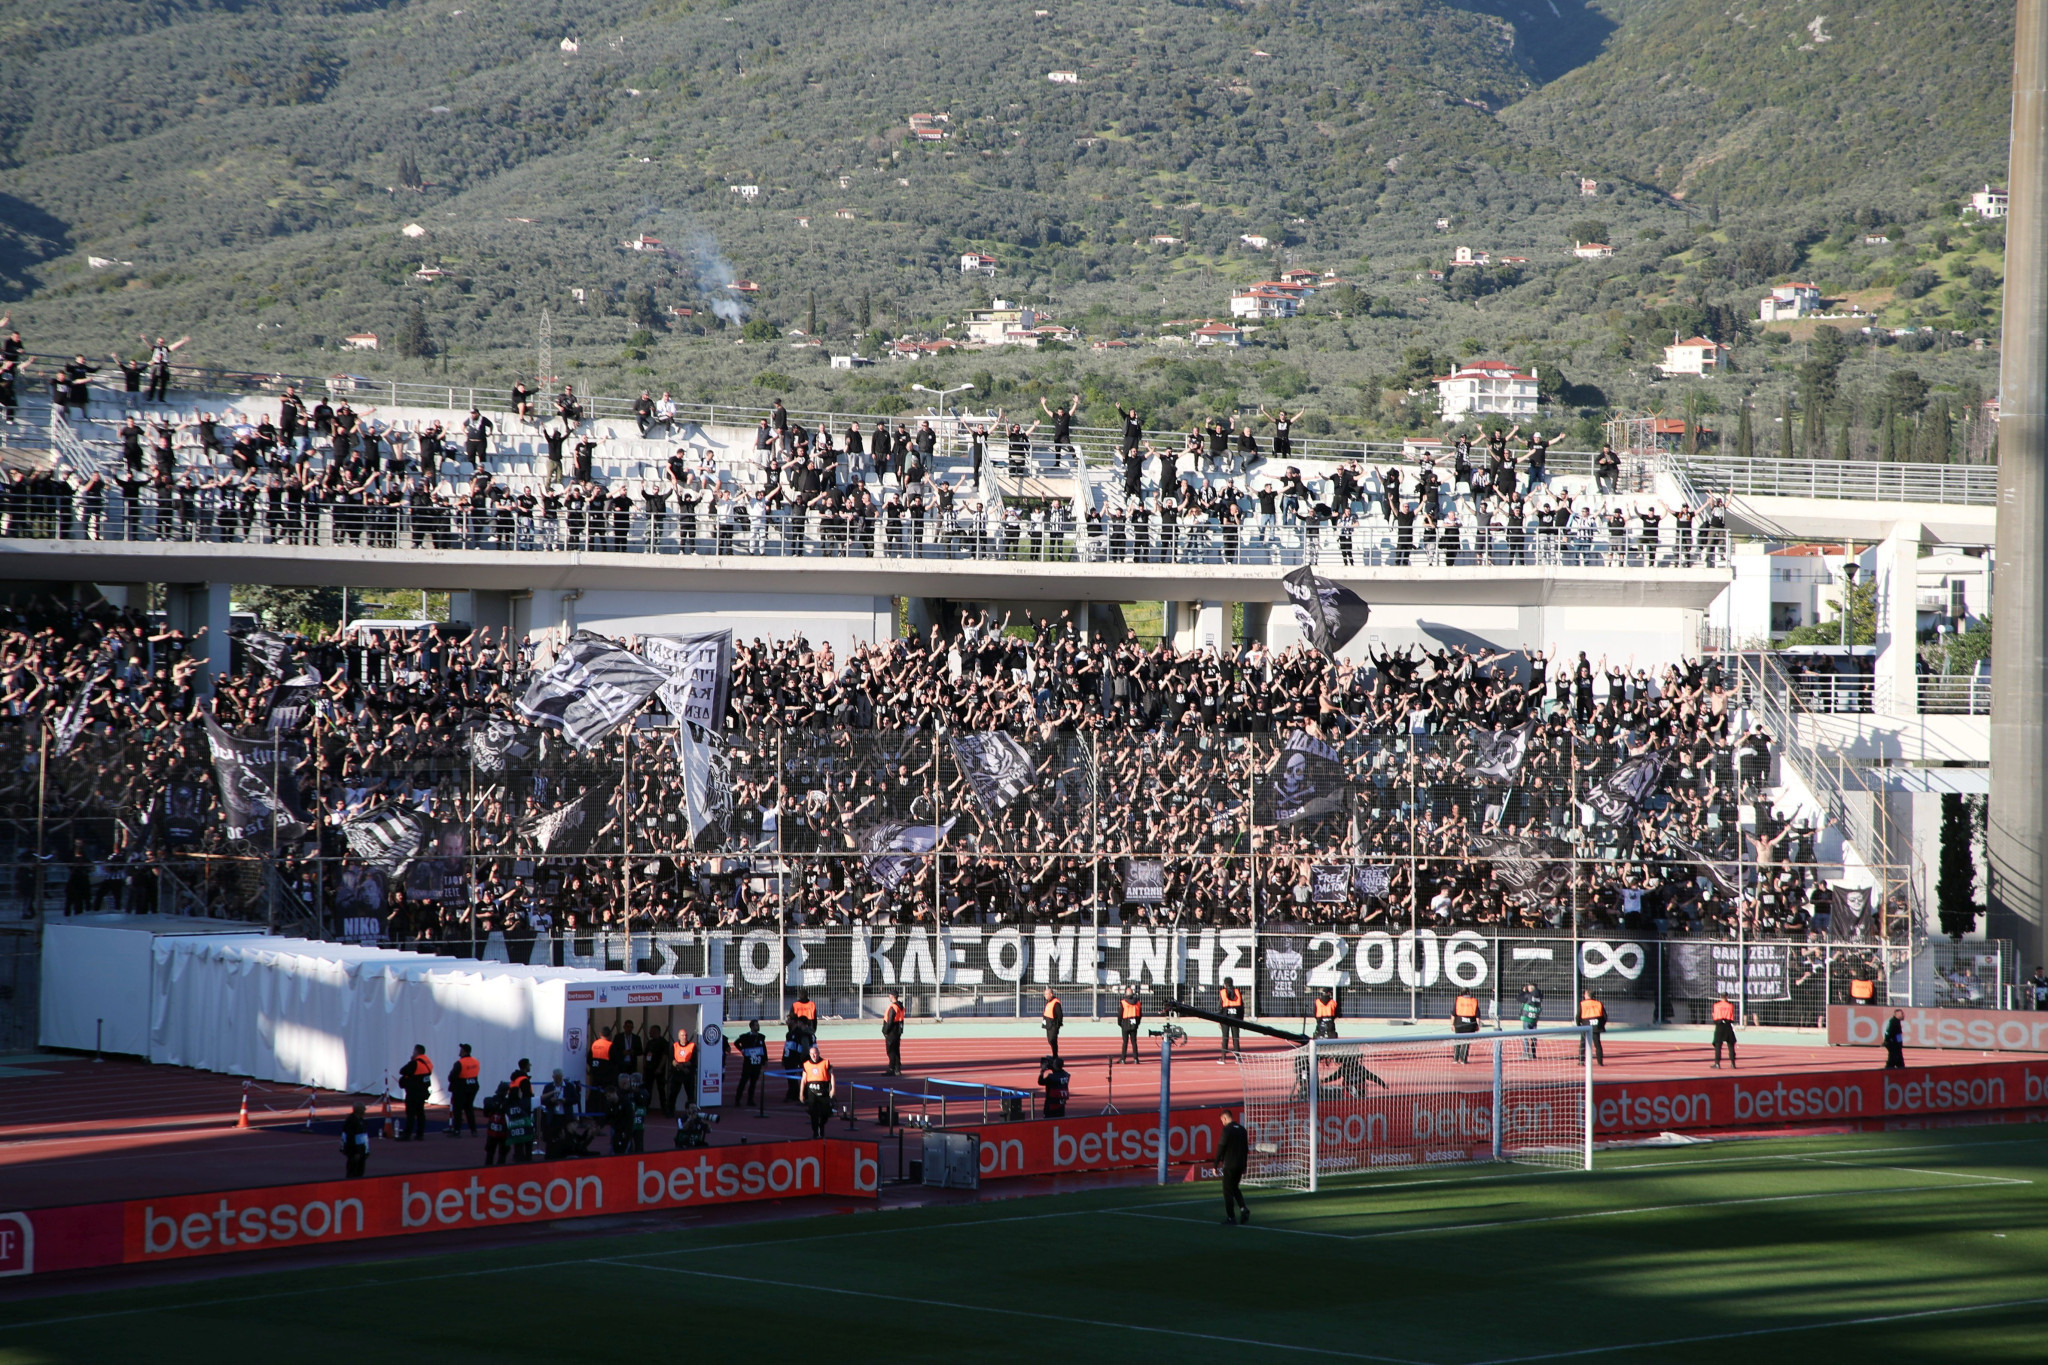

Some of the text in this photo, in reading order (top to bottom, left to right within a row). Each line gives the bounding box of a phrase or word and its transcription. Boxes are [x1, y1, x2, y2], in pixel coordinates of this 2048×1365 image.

[1314, 881, 1347, 893] DALTON
[1317, 873, 1342, 884] FREE
[851, 926, 1258, 986] ΚΛΕΟΜΕΝΗΣ
[1306, 929, 1489, 987] 2006
[1716, 963, 1737, 977] ΓΙΑ
[1734, 1081, 1863, 1119] betsson
[1884, 1073, 2005, 1110] betsson
[1053, 1122, 1212, 1165] betsson
[637, 1155, 821, 1204] betsson
[402, 1174, 603, 1227] betsson
[145, 1198, 364, 1253] betsson
